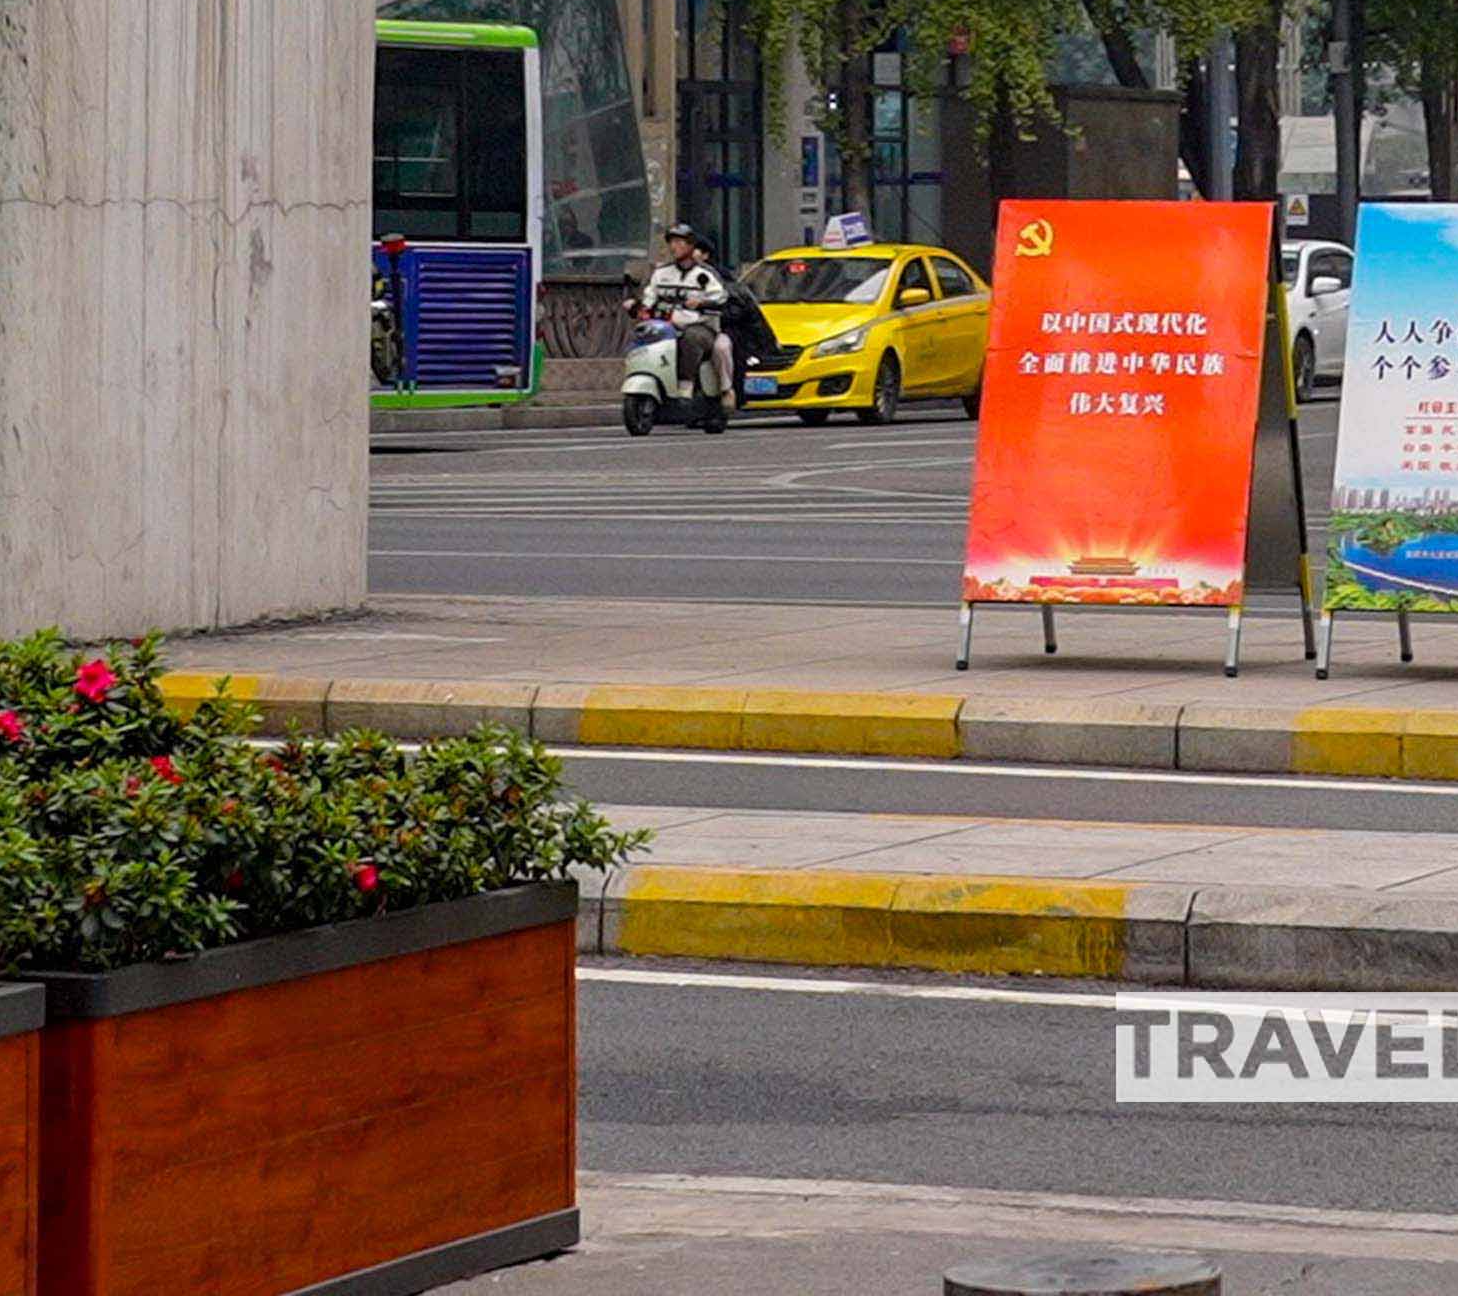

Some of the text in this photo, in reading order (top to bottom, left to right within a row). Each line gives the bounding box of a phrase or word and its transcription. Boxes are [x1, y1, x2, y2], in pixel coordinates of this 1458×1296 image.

[1042, 311, 1207, 335] 以中国式现代化
[1020, 351, 1226, 375] 全面推进中华民族
[1070, 391, 1166, 415] 伟大复兴
